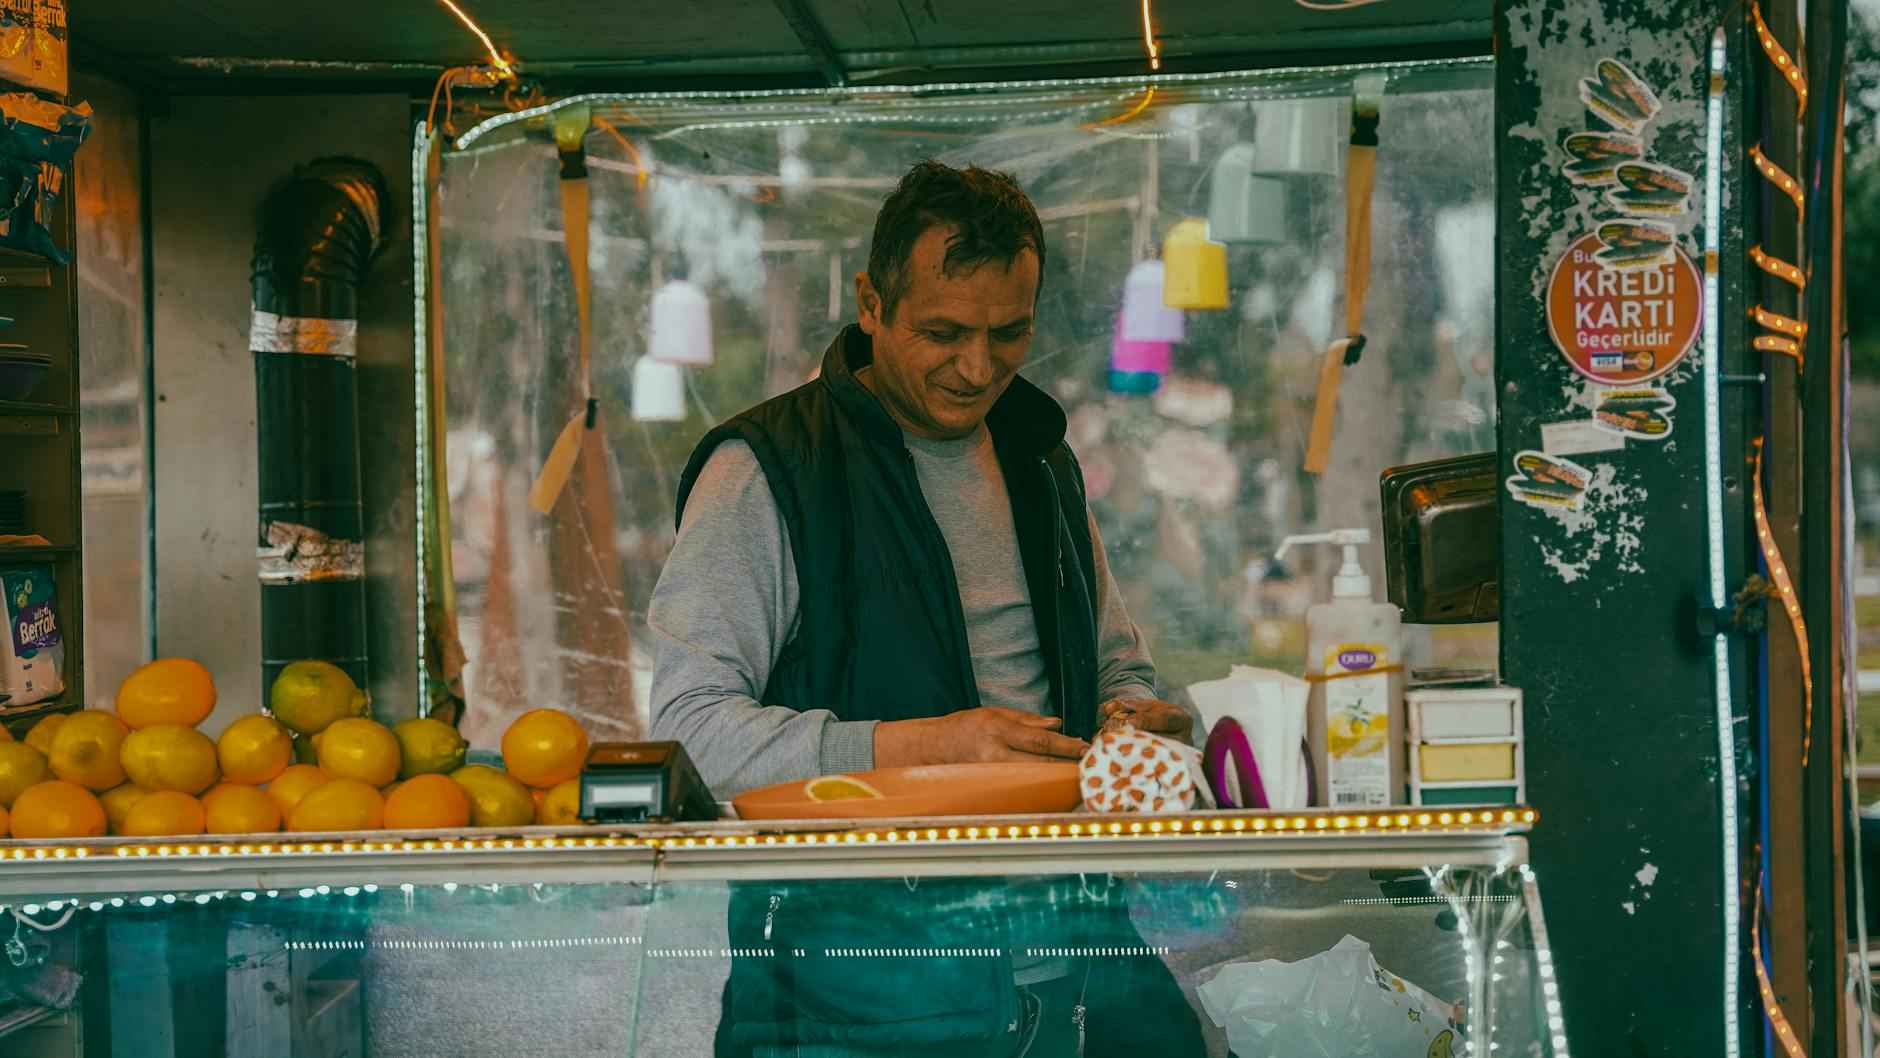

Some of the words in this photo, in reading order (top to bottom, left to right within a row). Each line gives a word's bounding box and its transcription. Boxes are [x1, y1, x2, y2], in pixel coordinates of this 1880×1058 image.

[1576, 300, 1675, 329] KARTI
[1577, 330, 1673, 349] Geçerlidir
[20, 612, 56, 645] Berrak
